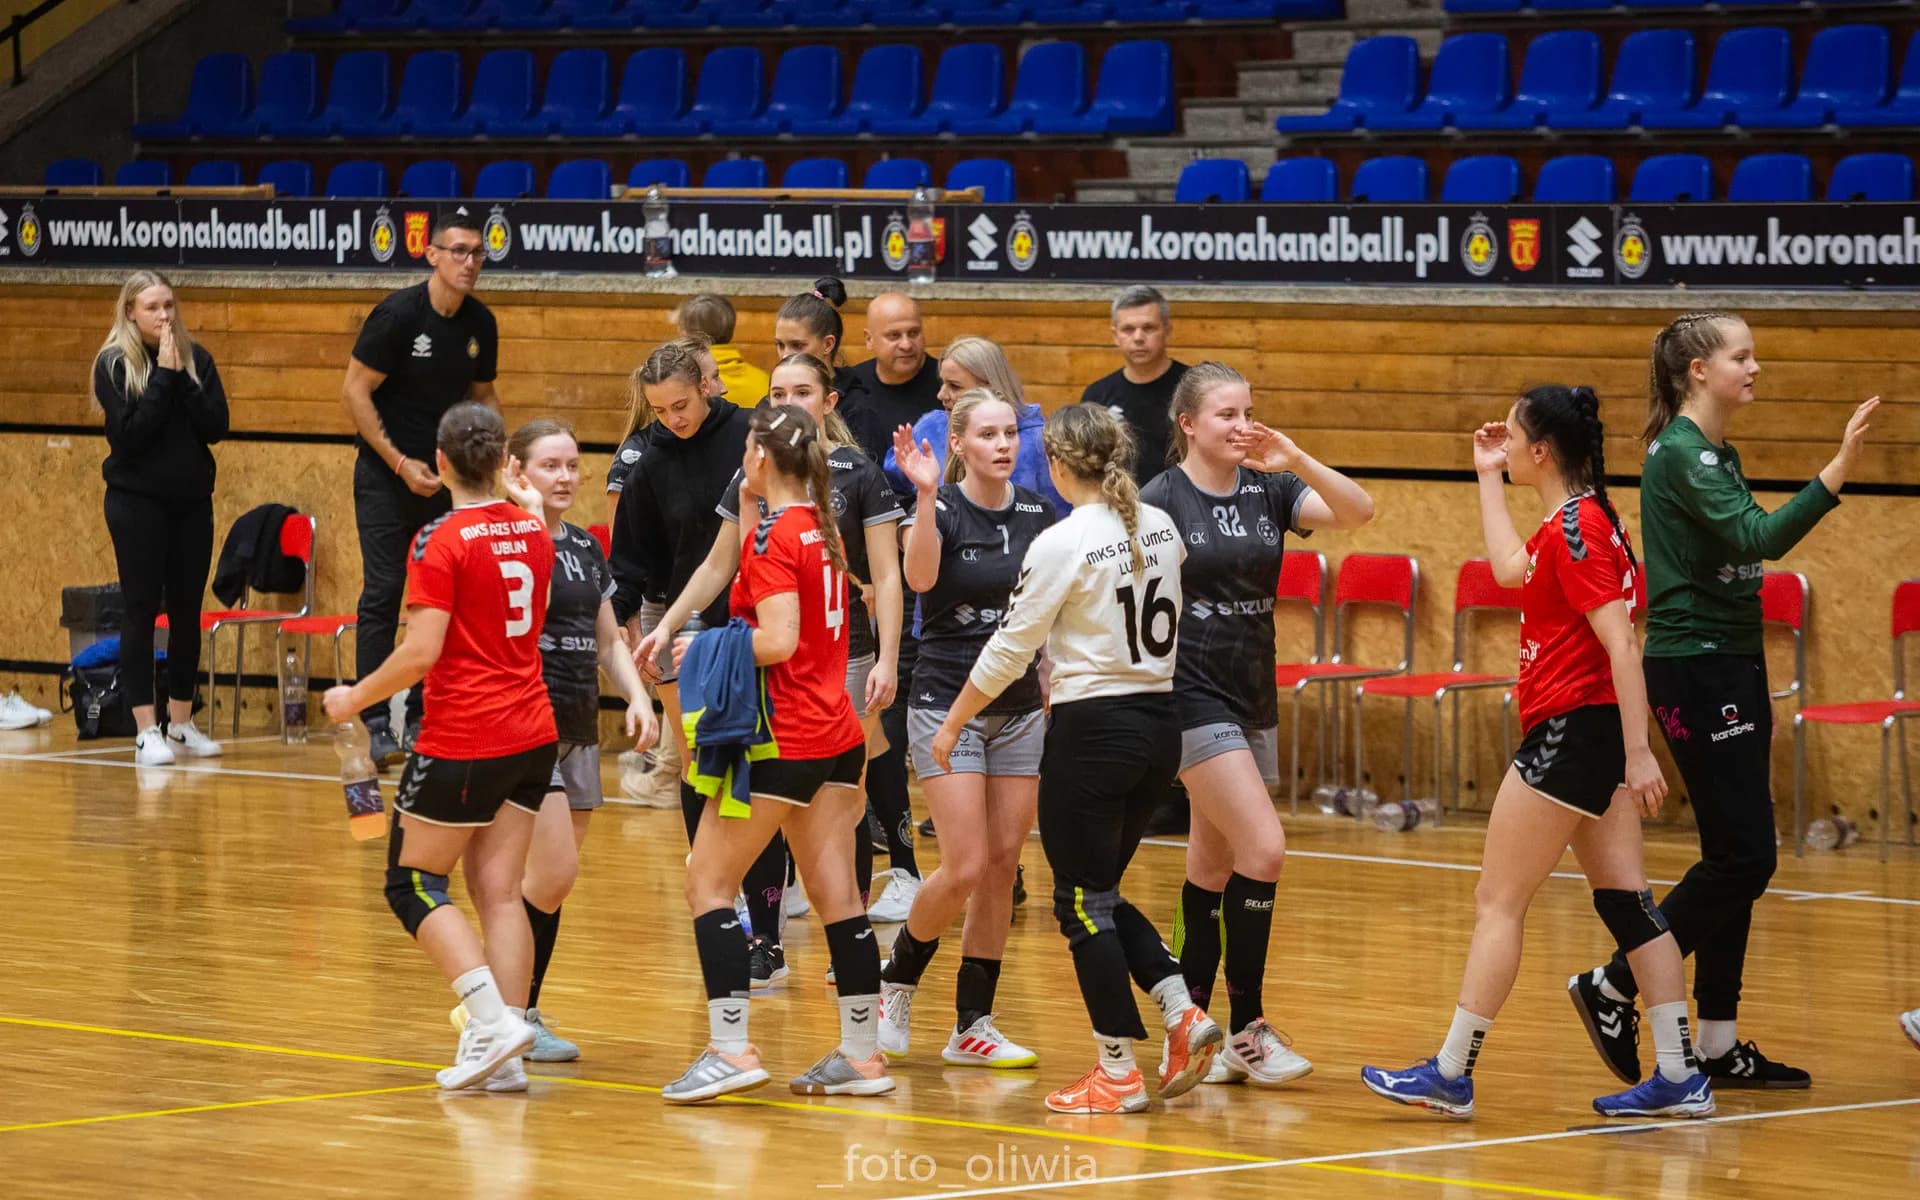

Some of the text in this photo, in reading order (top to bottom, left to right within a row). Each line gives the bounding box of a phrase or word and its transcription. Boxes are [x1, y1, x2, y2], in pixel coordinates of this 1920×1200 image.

[48, 206, 361, 264] www.koronahandball.pl
[520, 210, 872, 273] www.kornahandball.pl
[1046, 214, 1450, 278] www.koronahandball.pl
[1660, 216, 1920, 265] www.koronah
[1015, 502, 1043, 513] Joma
[1212, 505, 1248, 537] 32
[460, 519, 542, 541] MKS AZS UMCS
[1190, 531, 1206, 545] CK
[962, 549, 977, 561] CK
[1086, 529, 1174, 565] MKS AZ UMCS
[555, 550, 586, 581] 14
[1119, 553, 1159, 575] LUIN
[1737, 562, 1763, 580] SUZ
[499, 560, 535, 638] 3
[823, 564, 844, 642] 4
[1116, 575, 1178, 665] 16
[561, 636, 597, 652] SUZ
